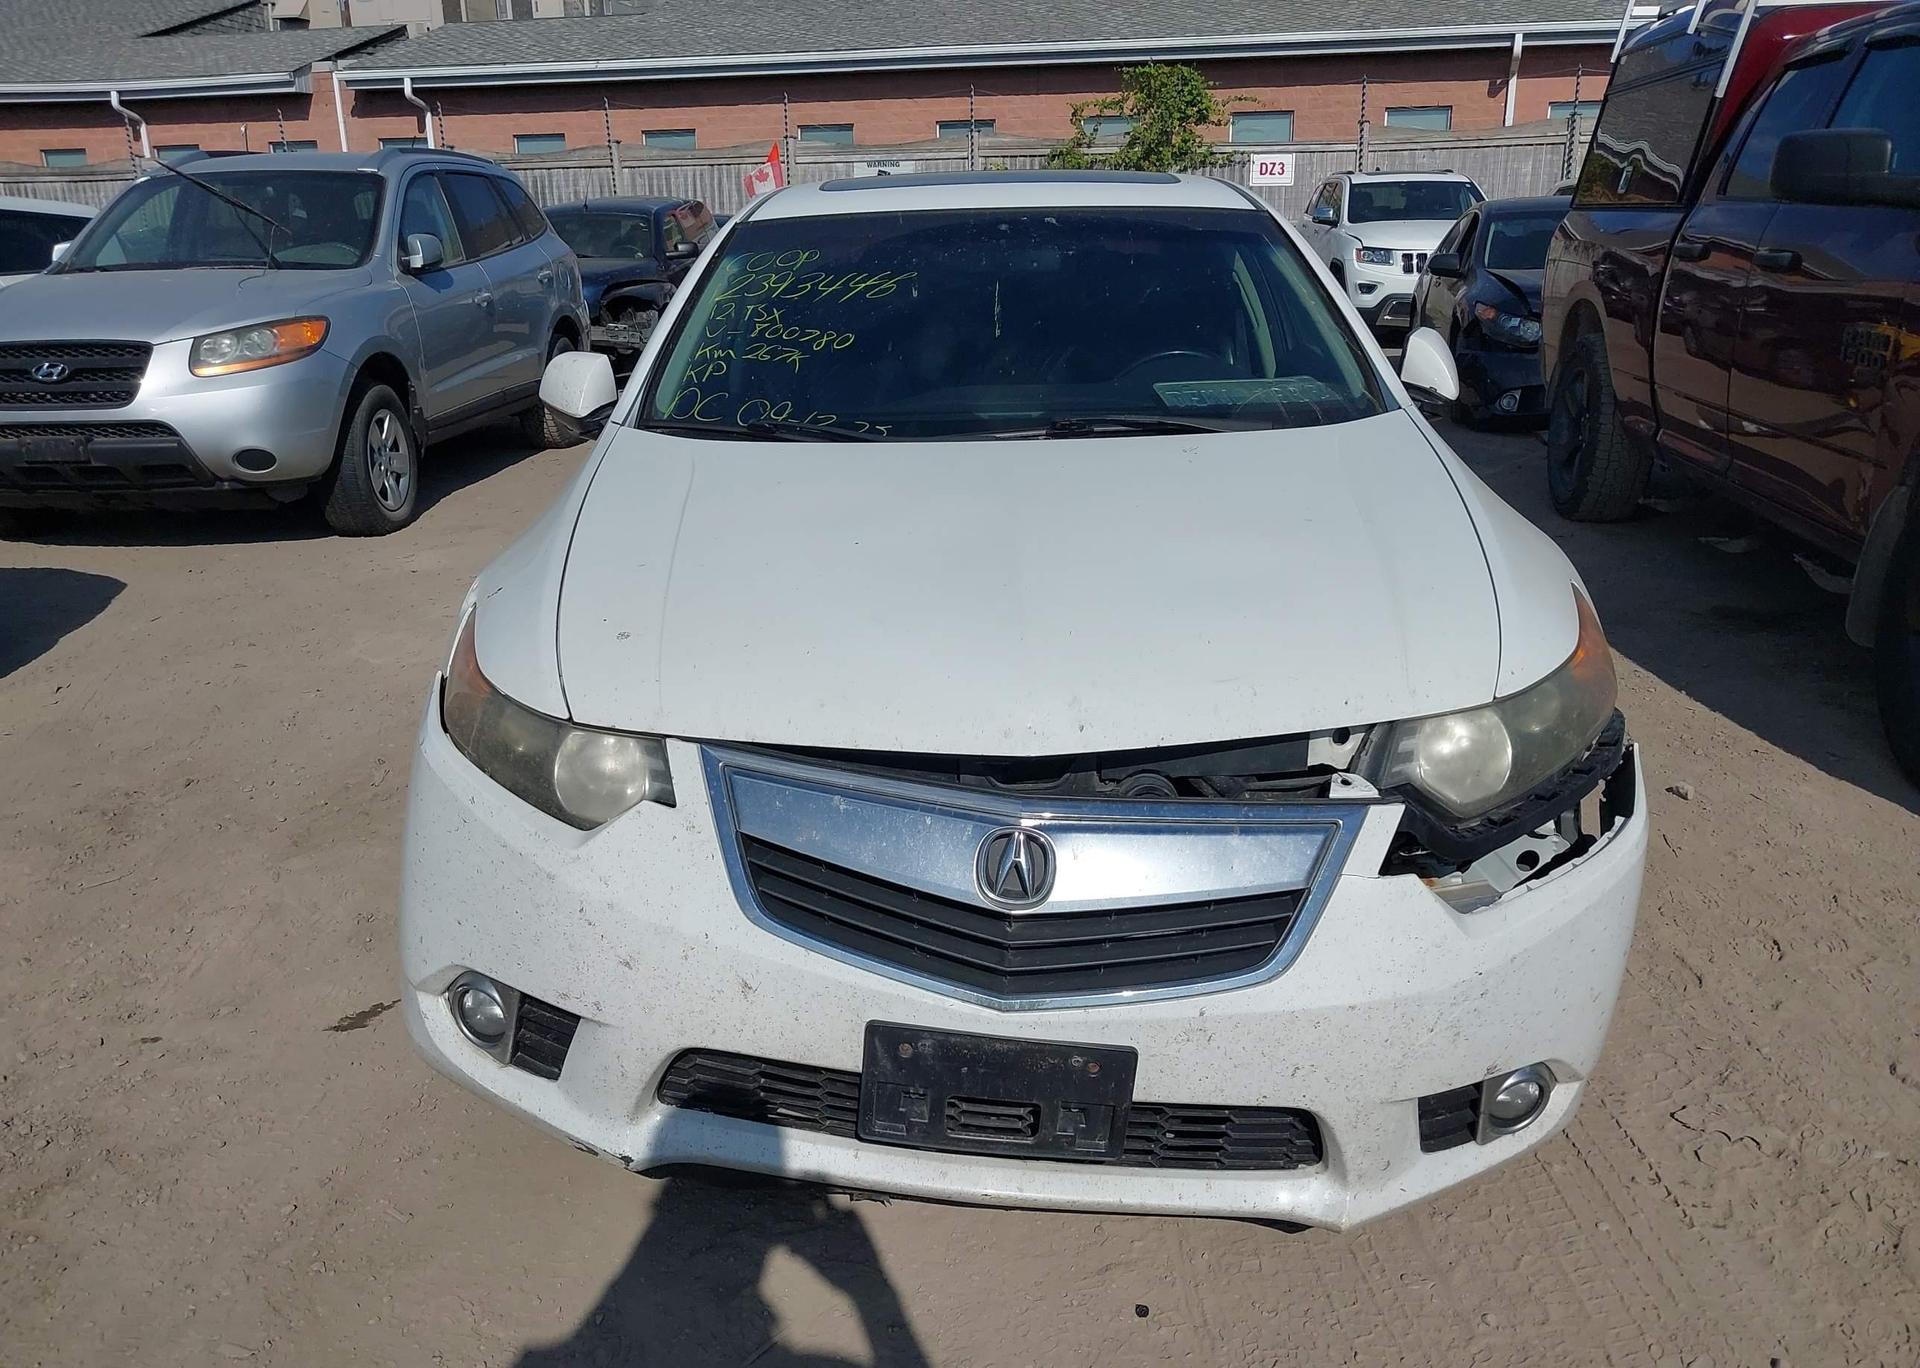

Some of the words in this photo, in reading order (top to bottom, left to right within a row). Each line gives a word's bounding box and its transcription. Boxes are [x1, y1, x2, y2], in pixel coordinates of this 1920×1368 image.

[866, 160, 900, 168] WARNING
[1259, 161, 1286, 176] DZ3
[744, 303, 786, 325] TSX
[682, 360, 727, 383] KP
